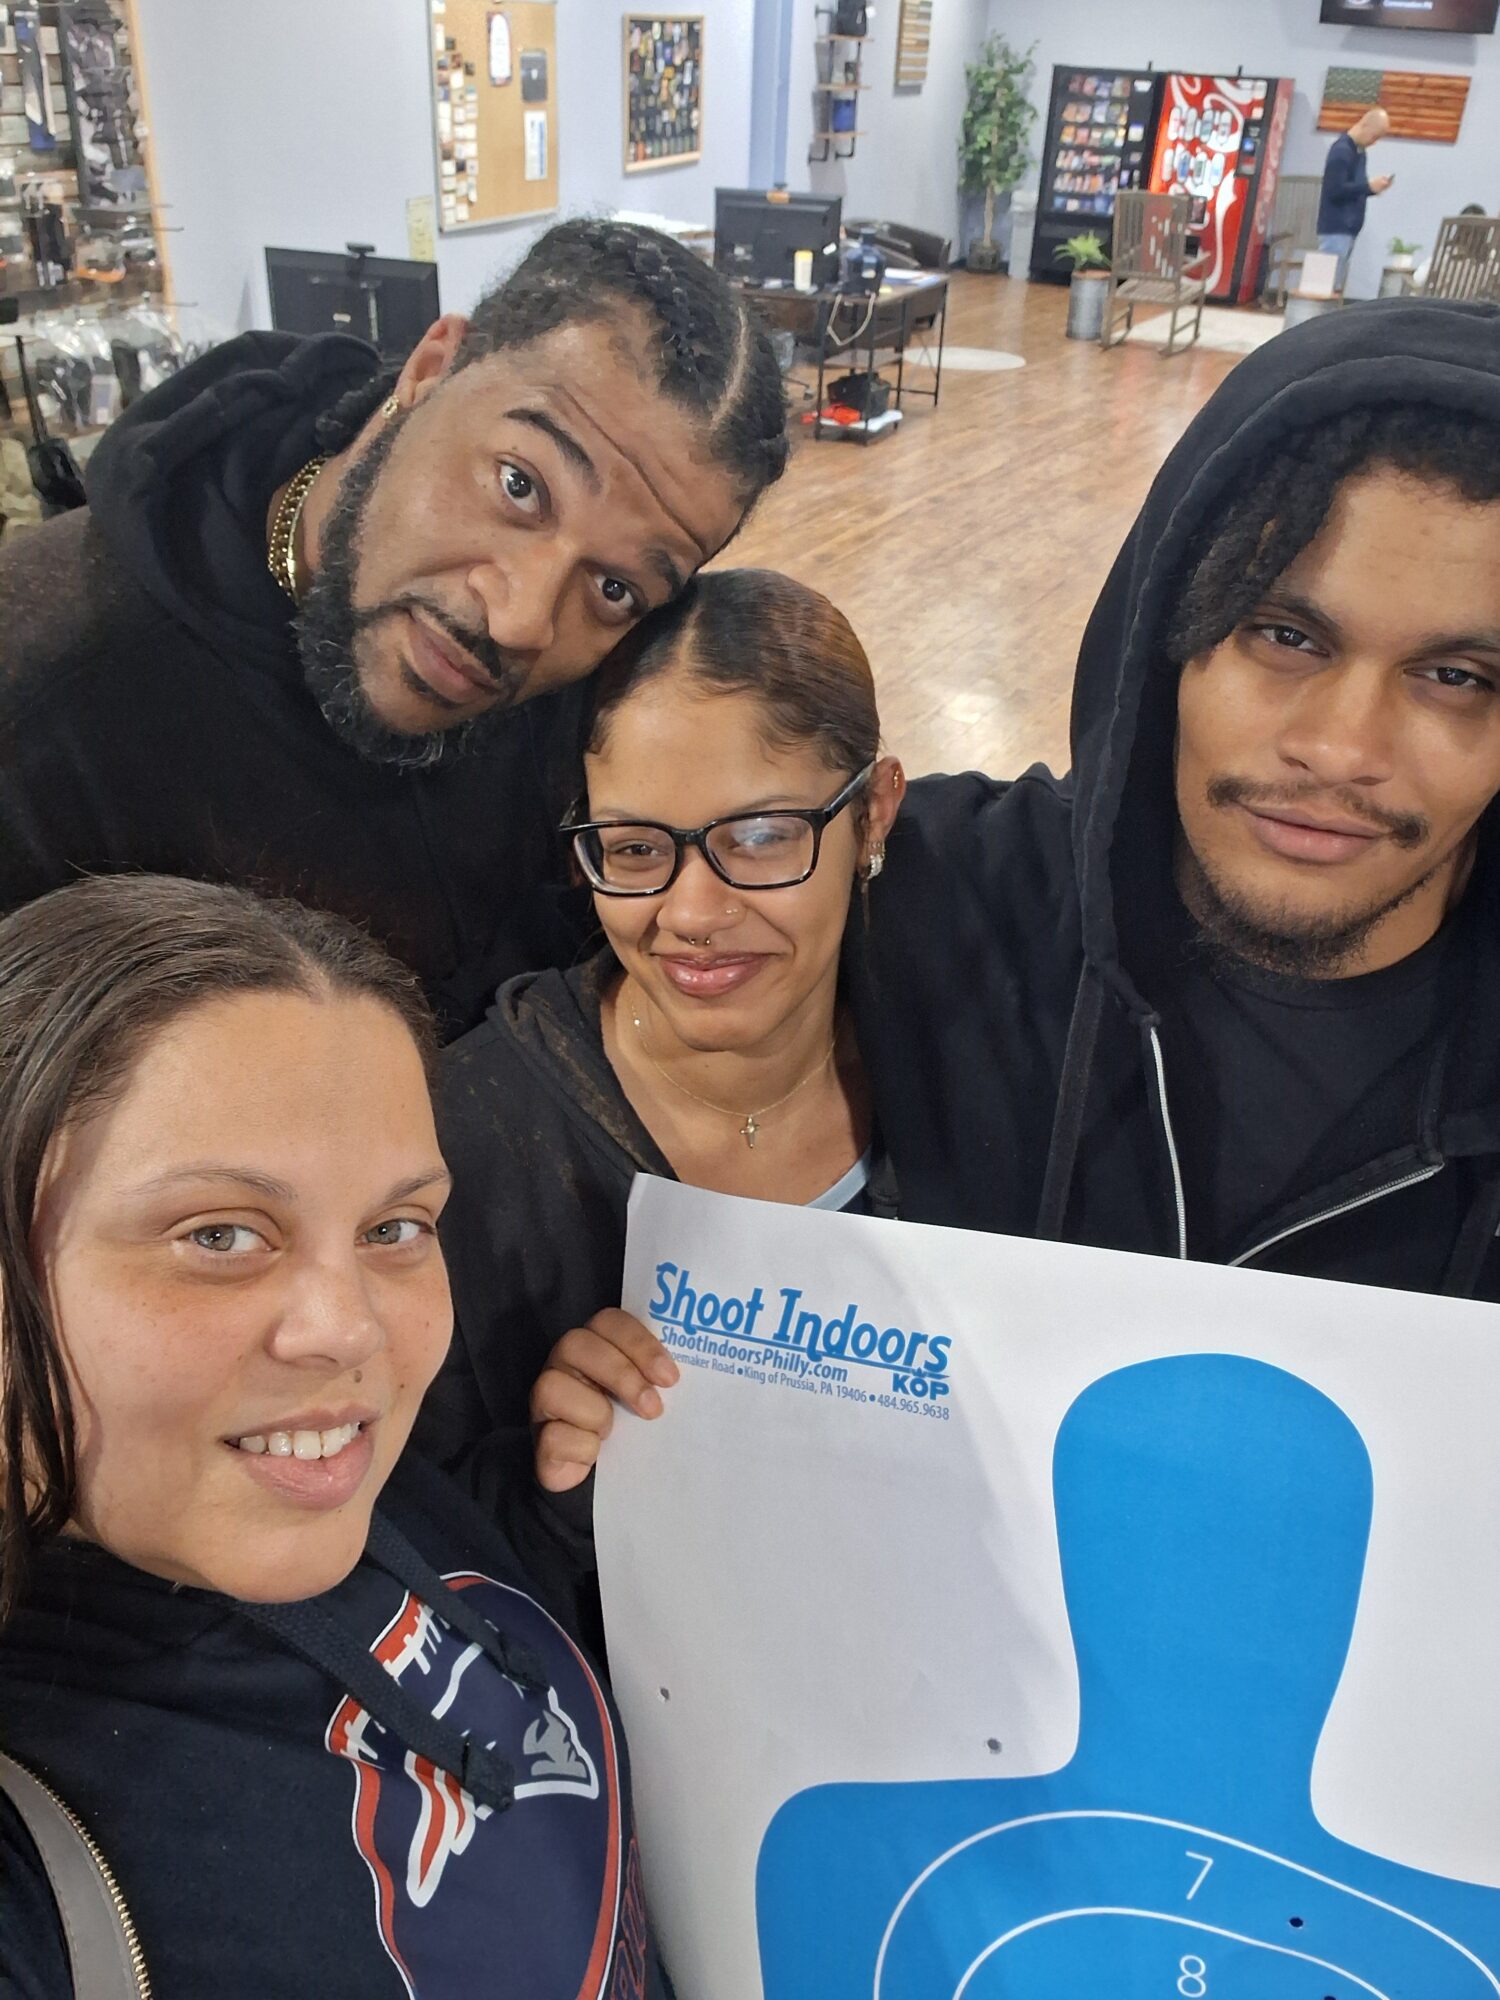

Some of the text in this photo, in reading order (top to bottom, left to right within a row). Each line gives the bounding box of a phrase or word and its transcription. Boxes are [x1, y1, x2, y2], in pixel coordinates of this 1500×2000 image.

[650, 1262, 953, 1374] Shoot Indoors
[660, 1325, 849, 1383] ShootIndoorsPhilly.com
[671, 1350, 950, 1421] oemaker Road King of Prussia, PA 19406 484.965.9638
[892, 1372, 950, 1401] KOP
[1185, 1850, 1214, 1900] 7
[1177, 1954, 1207, 1998] 8
